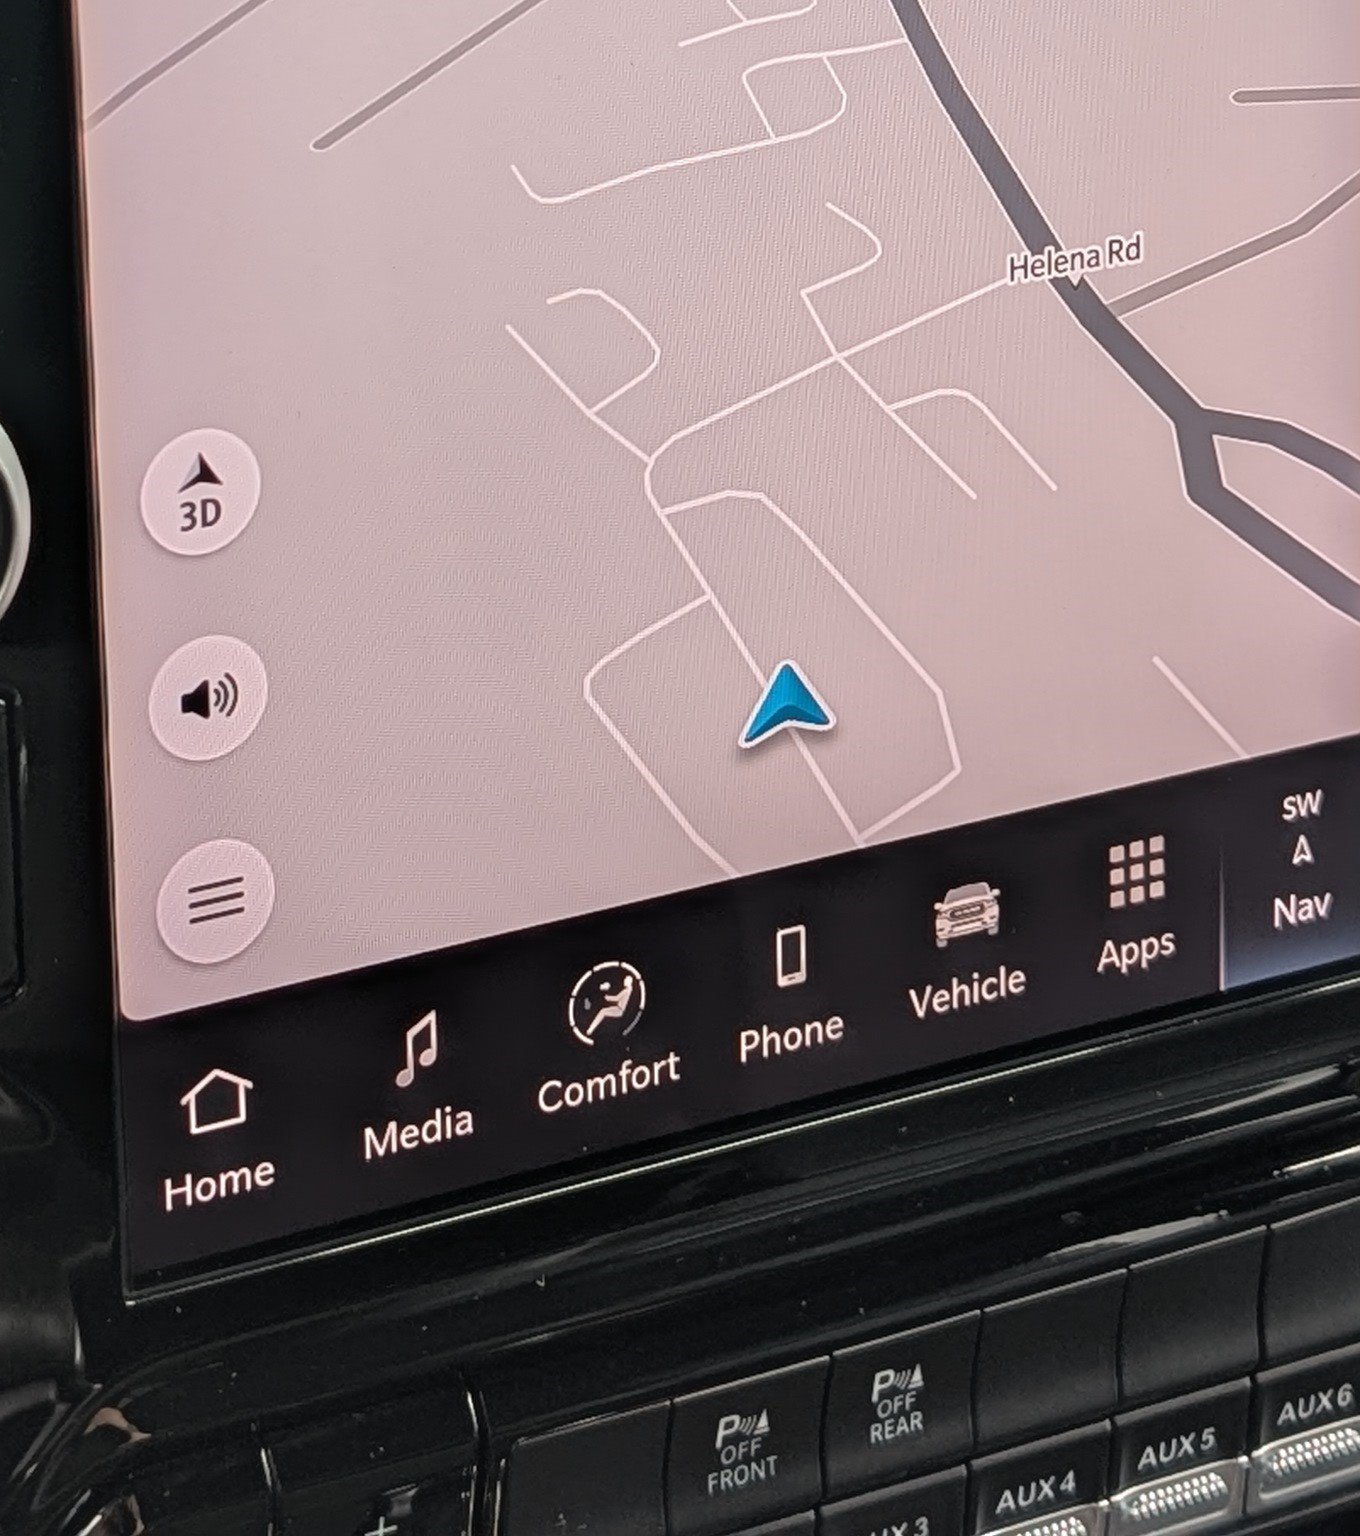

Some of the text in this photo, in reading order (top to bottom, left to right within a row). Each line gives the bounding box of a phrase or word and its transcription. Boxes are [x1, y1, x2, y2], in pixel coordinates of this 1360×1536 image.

[1010, 234, 1140, 282] Helena Rd
[180, 497, 222, 532] 3D
[1282, 789, 1323, 819] SW
[1273, 891, 1333, 928] Nav
[1097, 931, 1176, 973] Apps
[909, 966, 1026, 1019] Vehicle
[740, 1012, 844, 1063] Phone
[538, 1052, 680, 1113] Comfort
[363, 1105, 474, 1160] Media
[164, 1160, 275, 1212] Home
[876, 1391, 917, 1419] OFF
[1276, 1383, 1353, 1426] AUX 6
[870, 1411, 924, 1444] REAR
[1137, 1427, 1216, 1470] AUX 5
[720, 1437, 762, 1465] OFF
[708, 1455, 778, 1496] FRONT
[995, 1470, 1077, 1515] AUX 4
